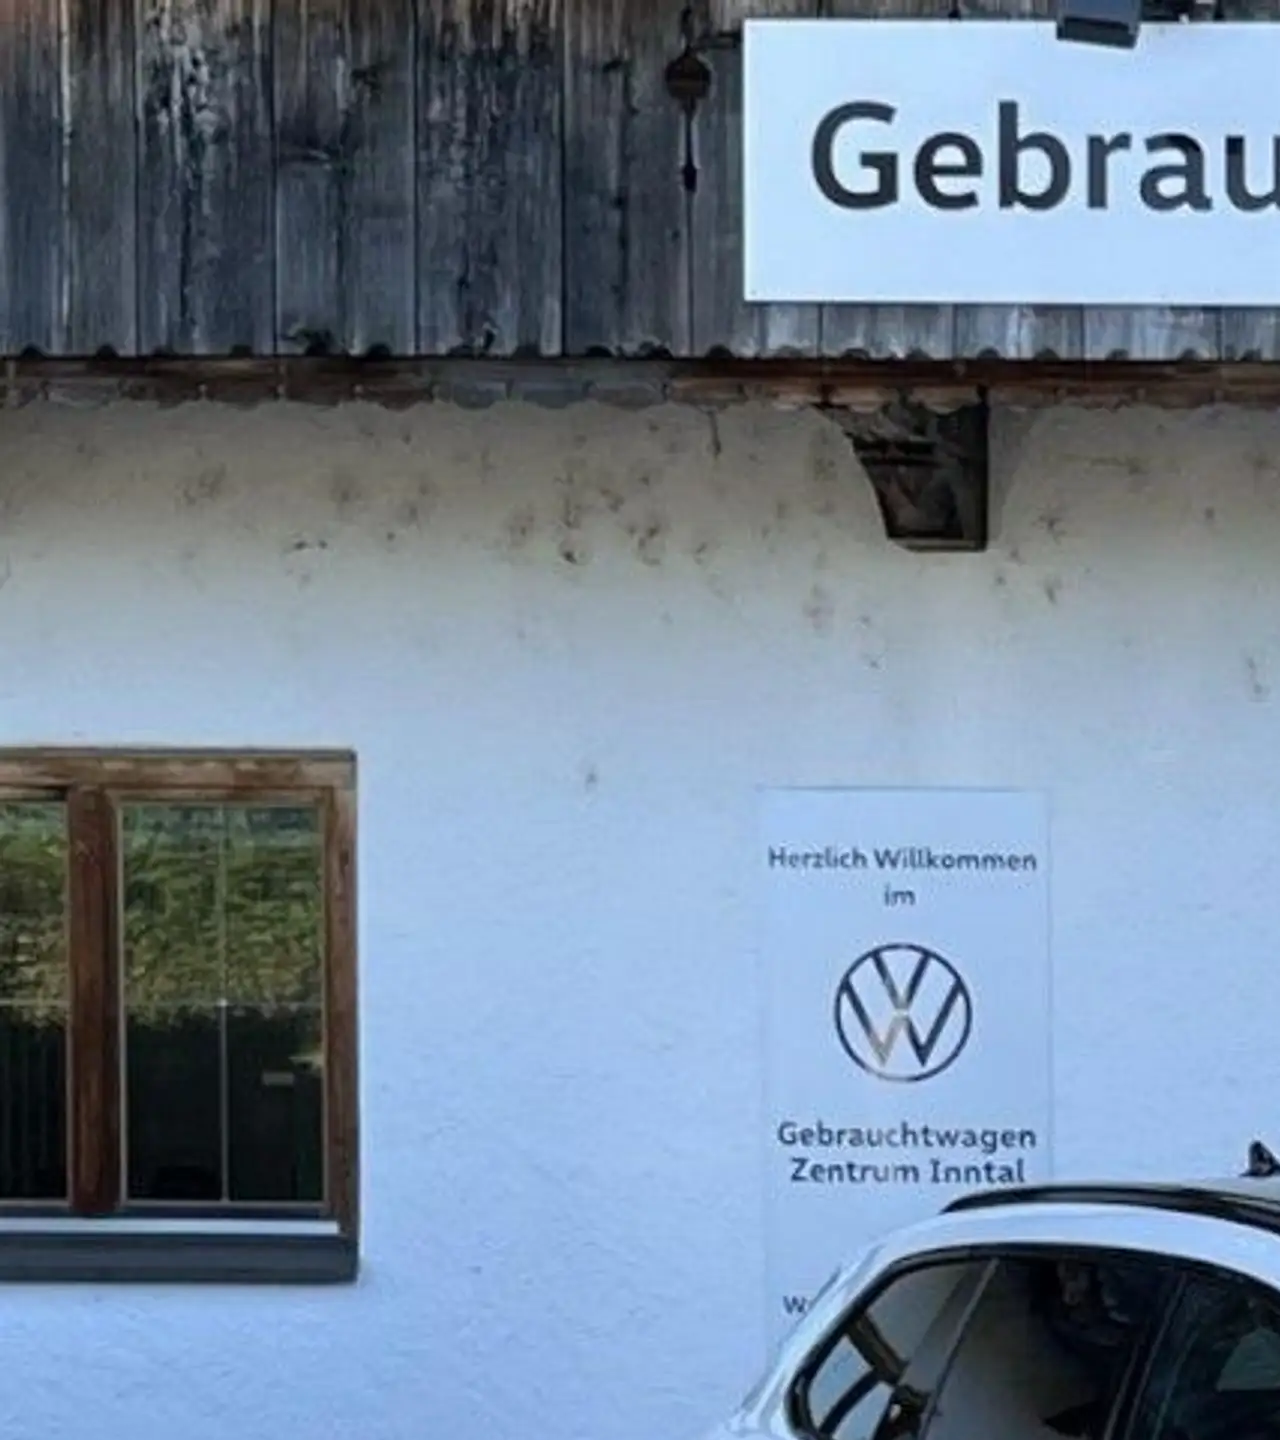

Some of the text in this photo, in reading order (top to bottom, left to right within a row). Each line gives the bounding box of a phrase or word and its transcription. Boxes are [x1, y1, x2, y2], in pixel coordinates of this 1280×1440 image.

[769, 847, 1036, 871] Herzlich Willkommen
[885, 886, 915, 905] im
[778, 1121, 1036, 1154] Gebrauchtwagen
[791, 1157, 1024, 1184] Zentrum Inntal
